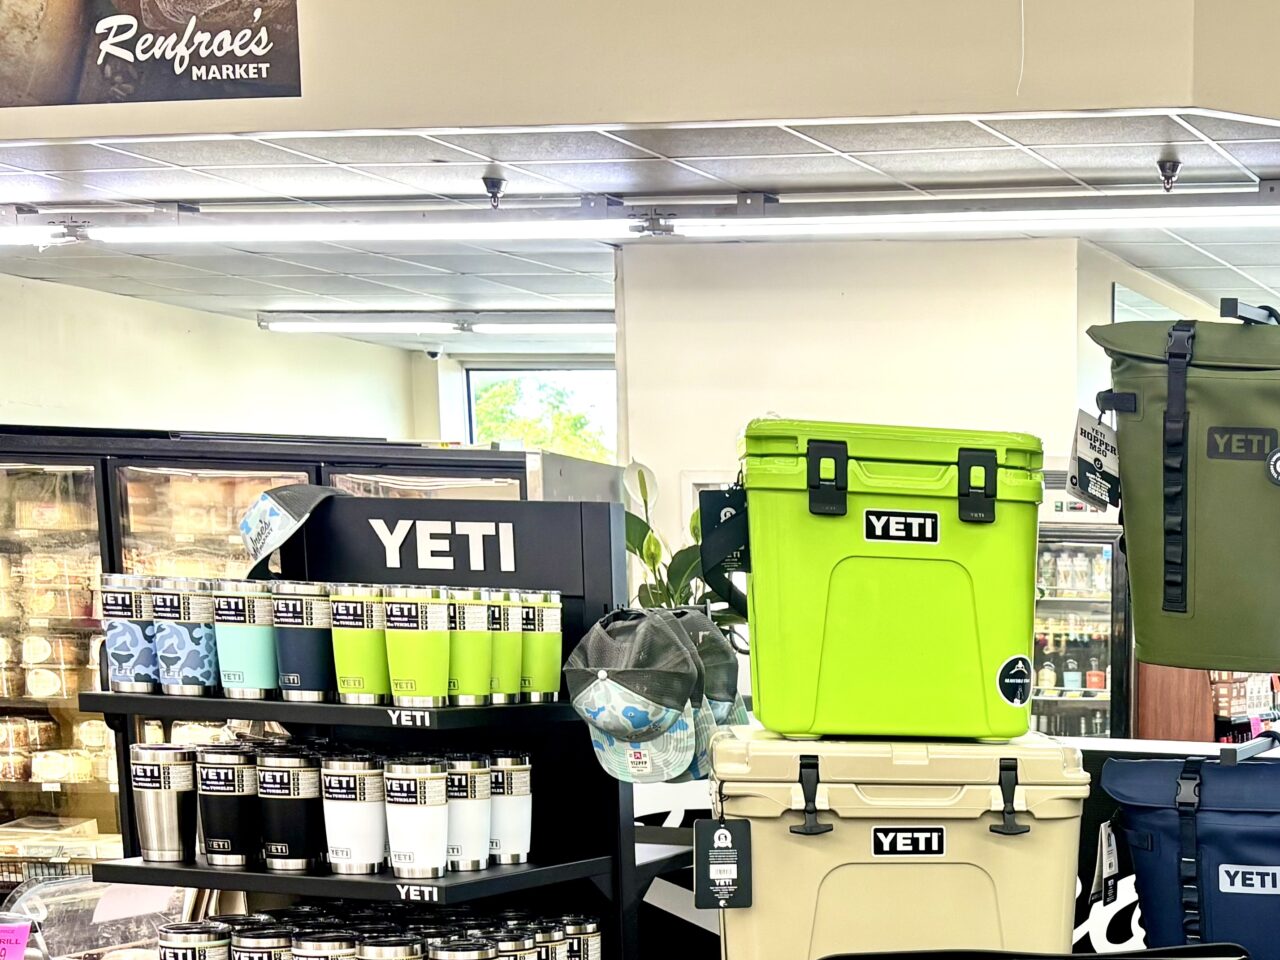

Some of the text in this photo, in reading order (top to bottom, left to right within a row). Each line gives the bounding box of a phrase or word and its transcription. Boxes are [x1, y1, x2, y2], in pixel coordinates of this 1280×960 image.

[96, 8, 273, 74] Renfroe's
[192, 63, 270, 80] MARKET
[1091, 427, 1105, 439] YETI
[1080, 427, 1116, 455] HOPPER
[1214, 433, 1270, 454] YETI
[1089, 442, 1107, 457] M20
[868, 515, 934, 538] YETI
[368, 519, 515, 572] YETI
[102, 593, 130, 605] YETI
[152, 594, 178, 606] YETI
[215, 597, 243, 610] YETI
[273, 599, 301, 611] YETI
[331, 602, 362, 614] YETI
[385, 604, 416, 616] YETI
[223, 673, 242, 681] YETI
[341, 679, 361, 687] YETI
[393, 681, 413, 690] YETI
[387, 710, 430, 727] YETI
[132, 765, 159, 777] YETI
[200, 768, 233, 780] YETI
[259, 771, 288, 783] YETI
[325, 776, 354, 788] YETI
[386, 779, 415, 792] YETI
[208, 841, 229, 849] YETI
[876, 833, 941, 851] YETI
[267, 845, 286, 853] YETI
[331, 849, 348, 857] YETI
[394, 853, 412, 861] YETI
[1224, 870, 1277, 888] YETI
[396, 885, 438, 902] YETI
